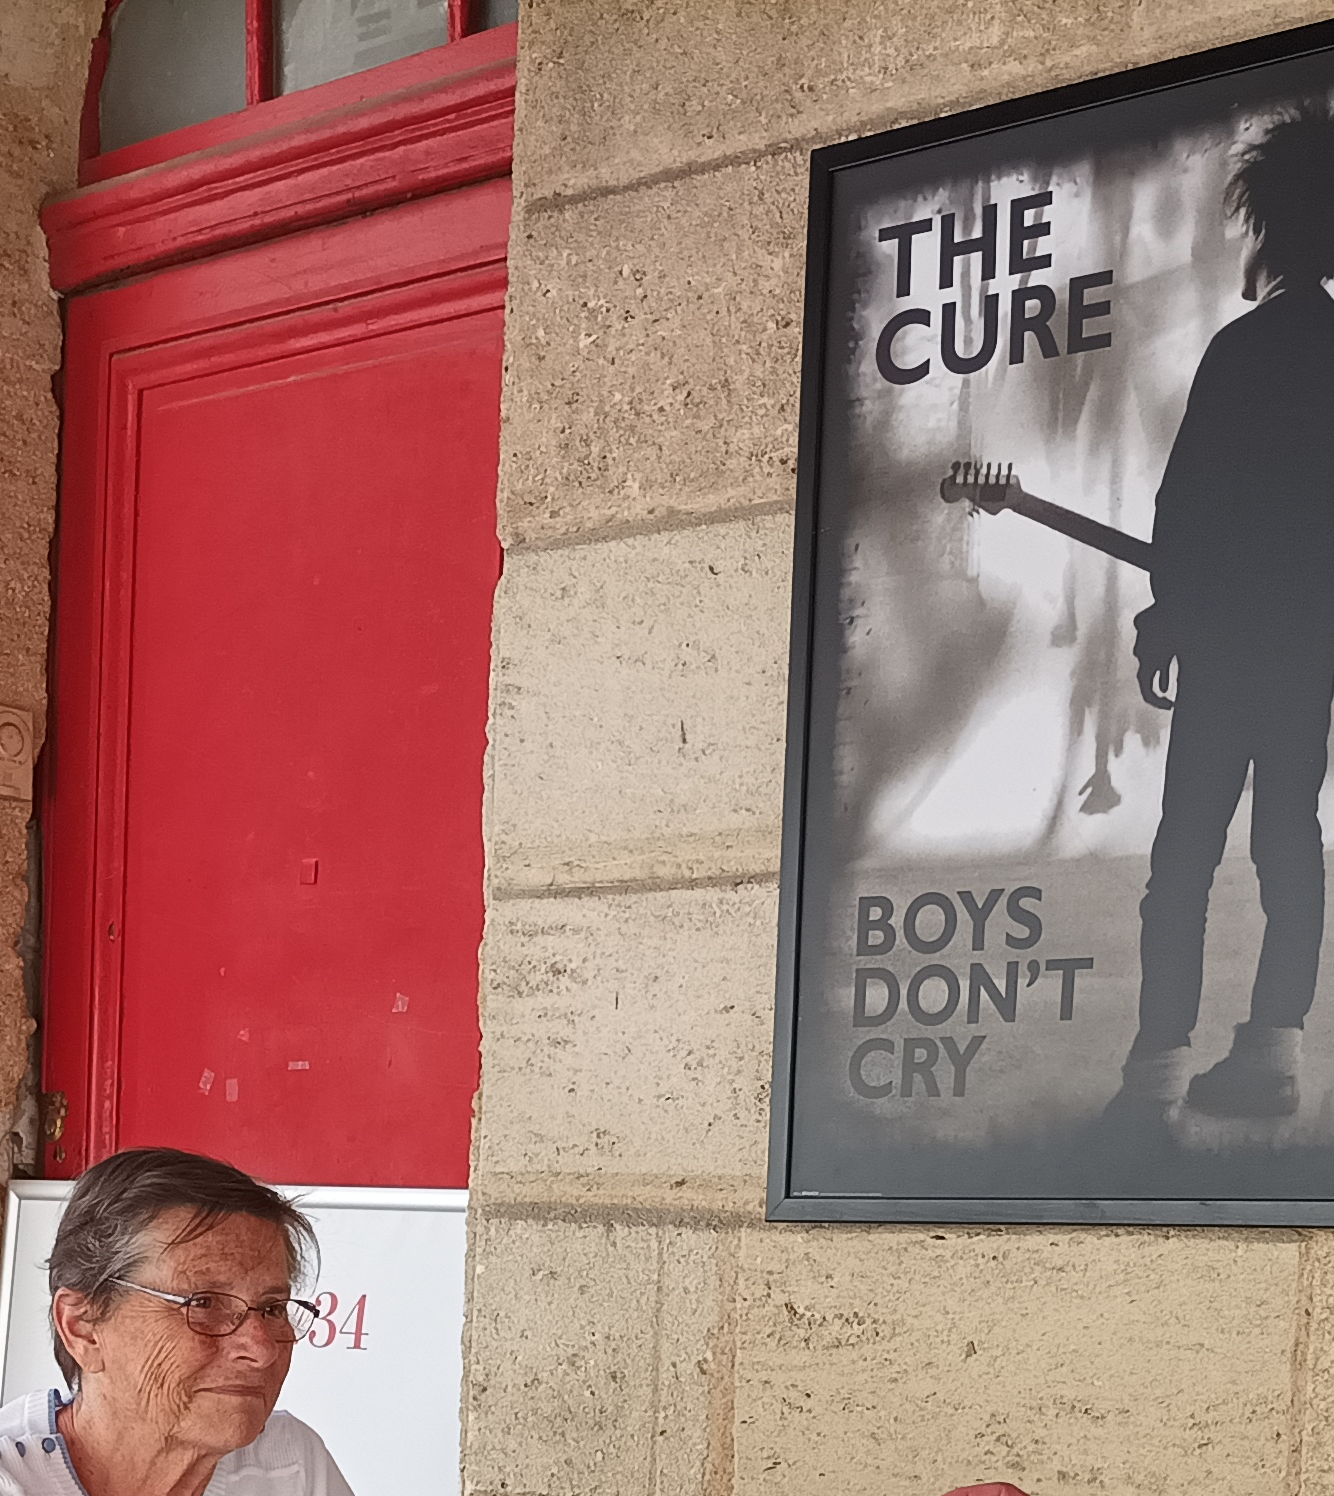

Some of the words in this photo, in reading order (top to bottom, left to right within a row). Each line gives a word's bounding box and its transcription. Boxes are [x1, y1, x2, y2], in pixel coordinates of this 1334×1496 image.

[877, 190, 1054, 299] THE
[875, 269, 1114, 386] CURE
[855, 885, 1043, 957] BOYS
[852, 957, 1095, 1028] DON'T
[848, 1035, 987, 1100] CRY
